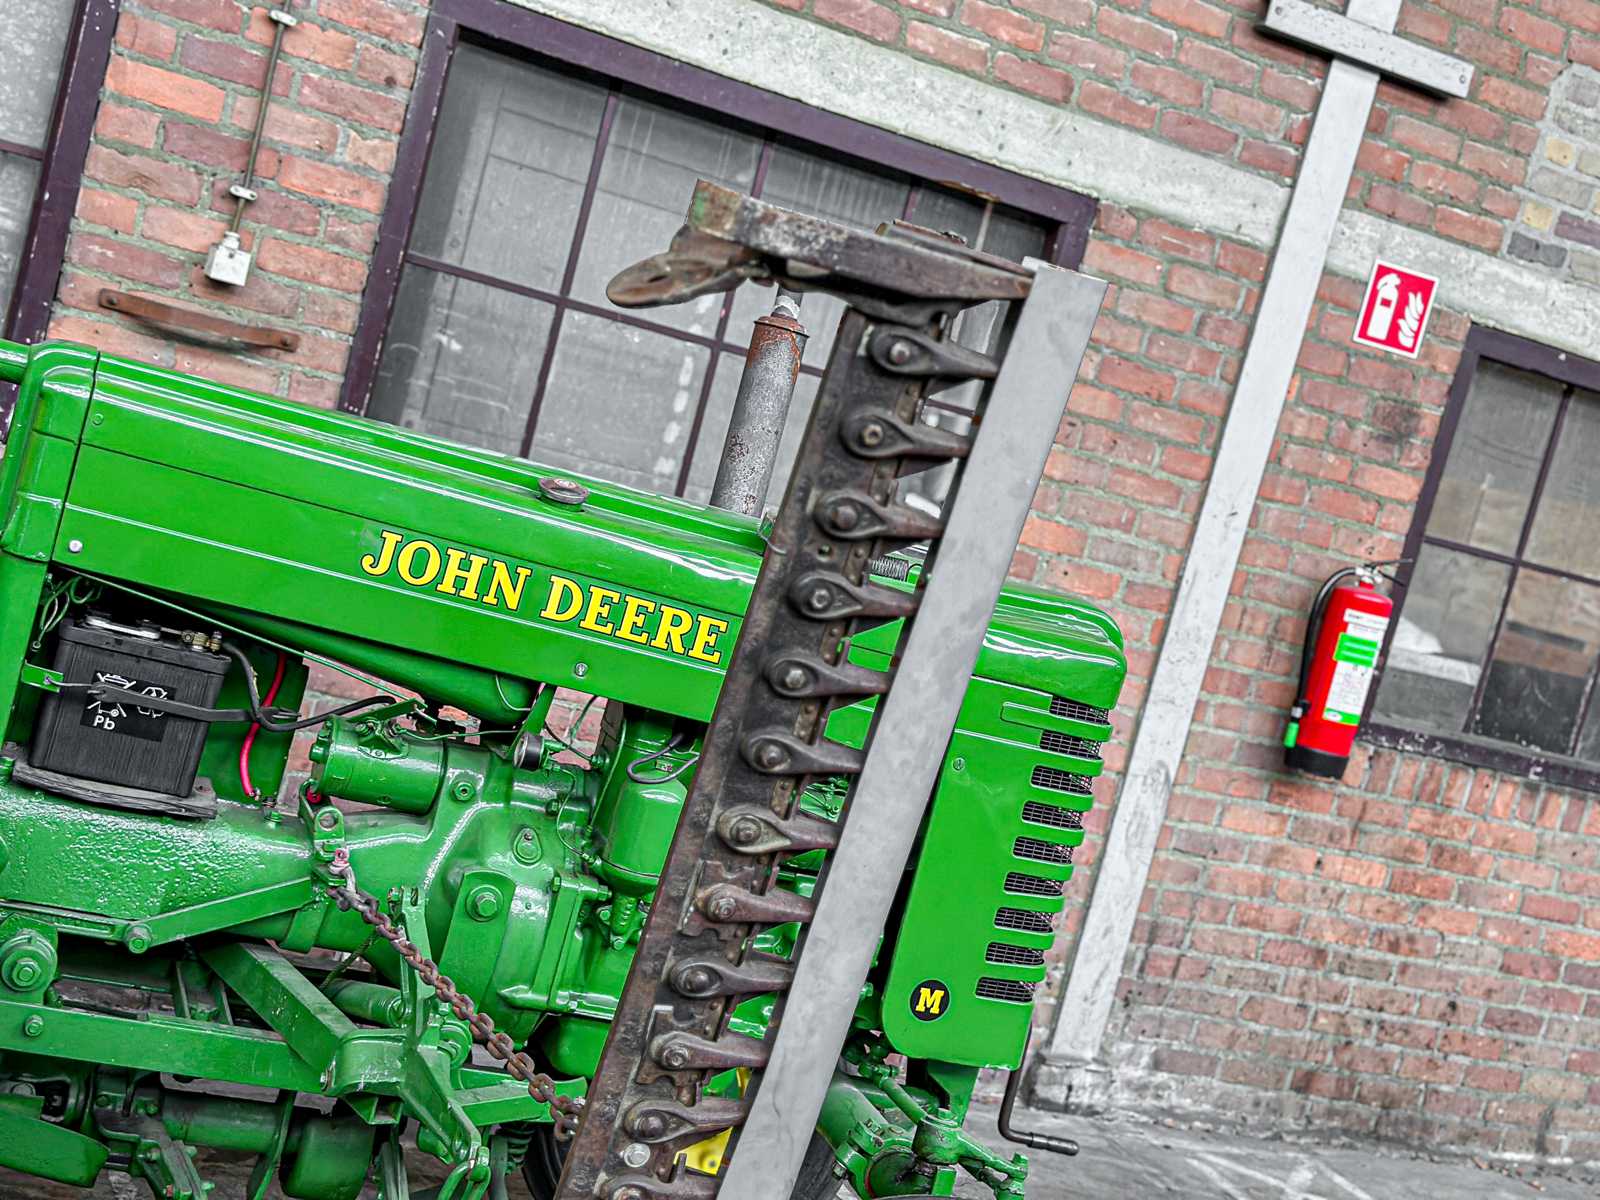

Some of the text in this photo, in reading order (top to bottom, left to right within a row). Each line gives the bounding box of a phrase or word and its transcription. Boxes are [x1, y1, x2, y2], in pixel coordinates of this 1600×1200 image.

[360, 530, 728, 664] JOHN DEERE
[93, 715, 115, 730] Pb
[915, 987, 945, 1014] M
